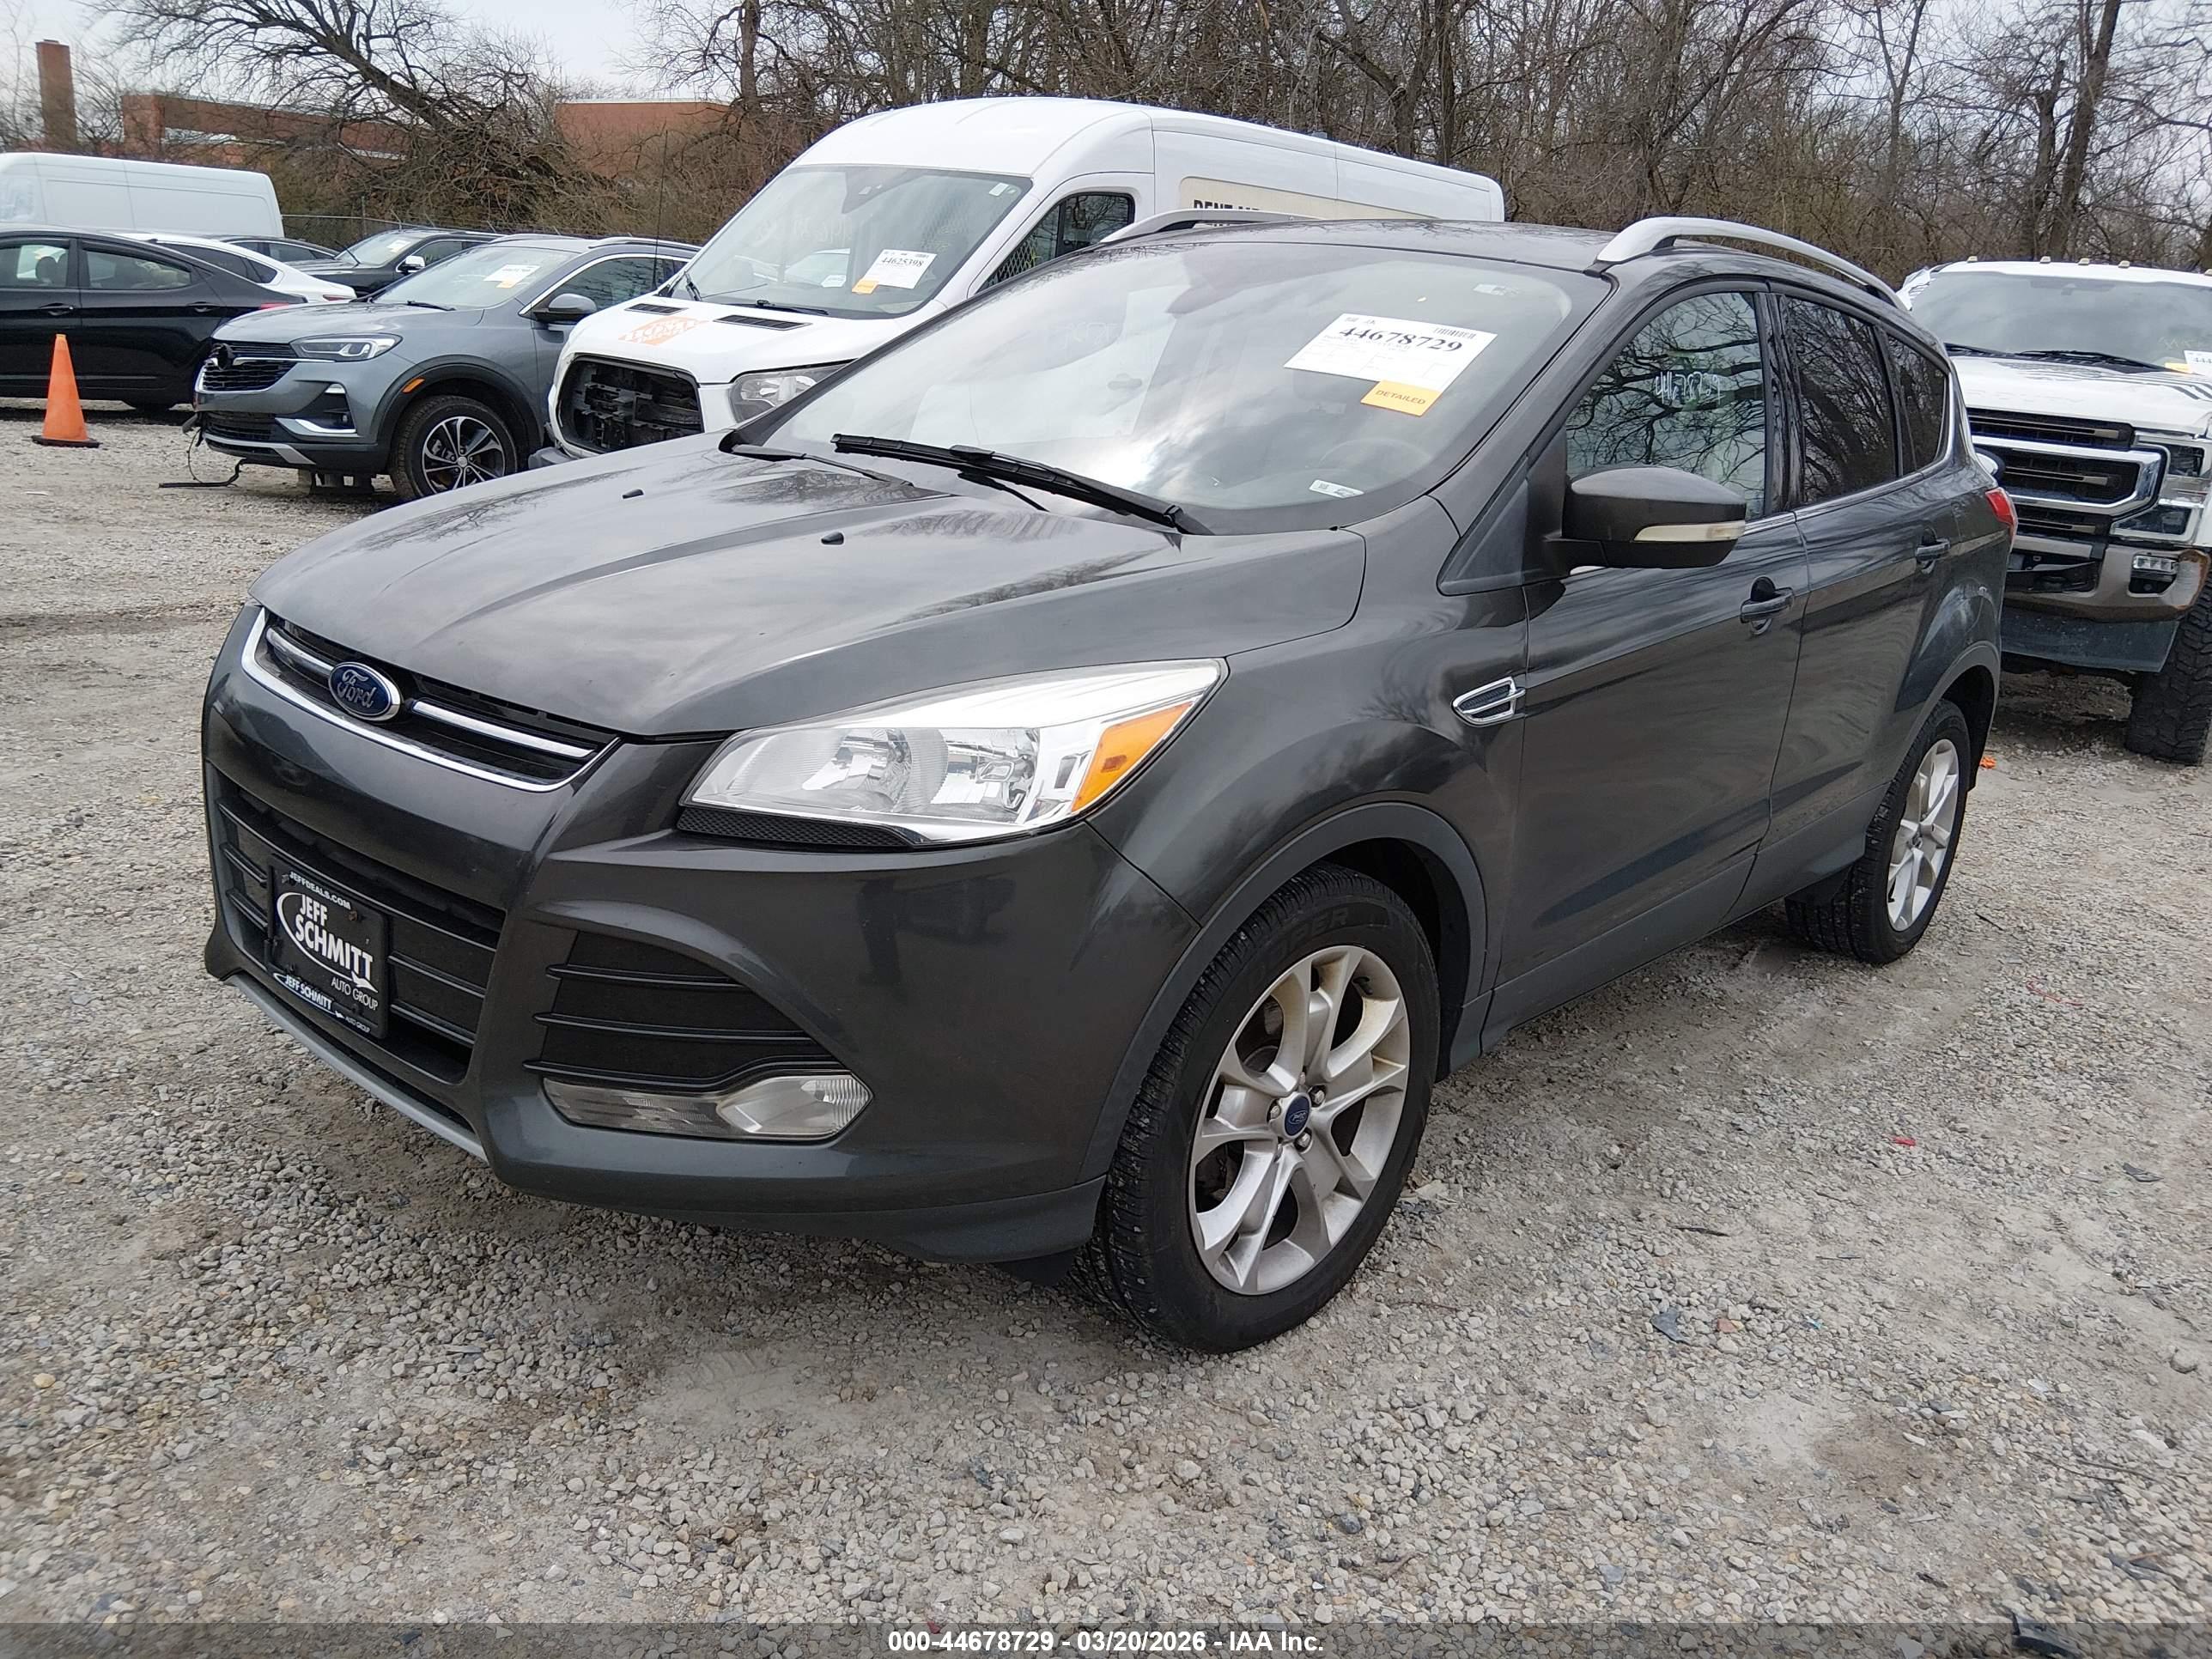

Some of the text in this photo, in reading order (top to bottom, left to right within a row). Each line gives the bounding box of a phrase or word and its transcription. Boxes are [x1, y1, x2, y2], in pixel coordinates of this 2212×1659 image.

[1338, 326, 1462, 352] 44678729
[1376, 389, 1425, 404] DETAILED
[337, 669, 377, 708] Ford
[300, 894, 328, 927] JEFF
[295, 914, 374, 981] SCHMITT
[285, 974, 332, 1011] JEFF SCHMITT
[331, 976, 379, 1012] AUTO GROUP
